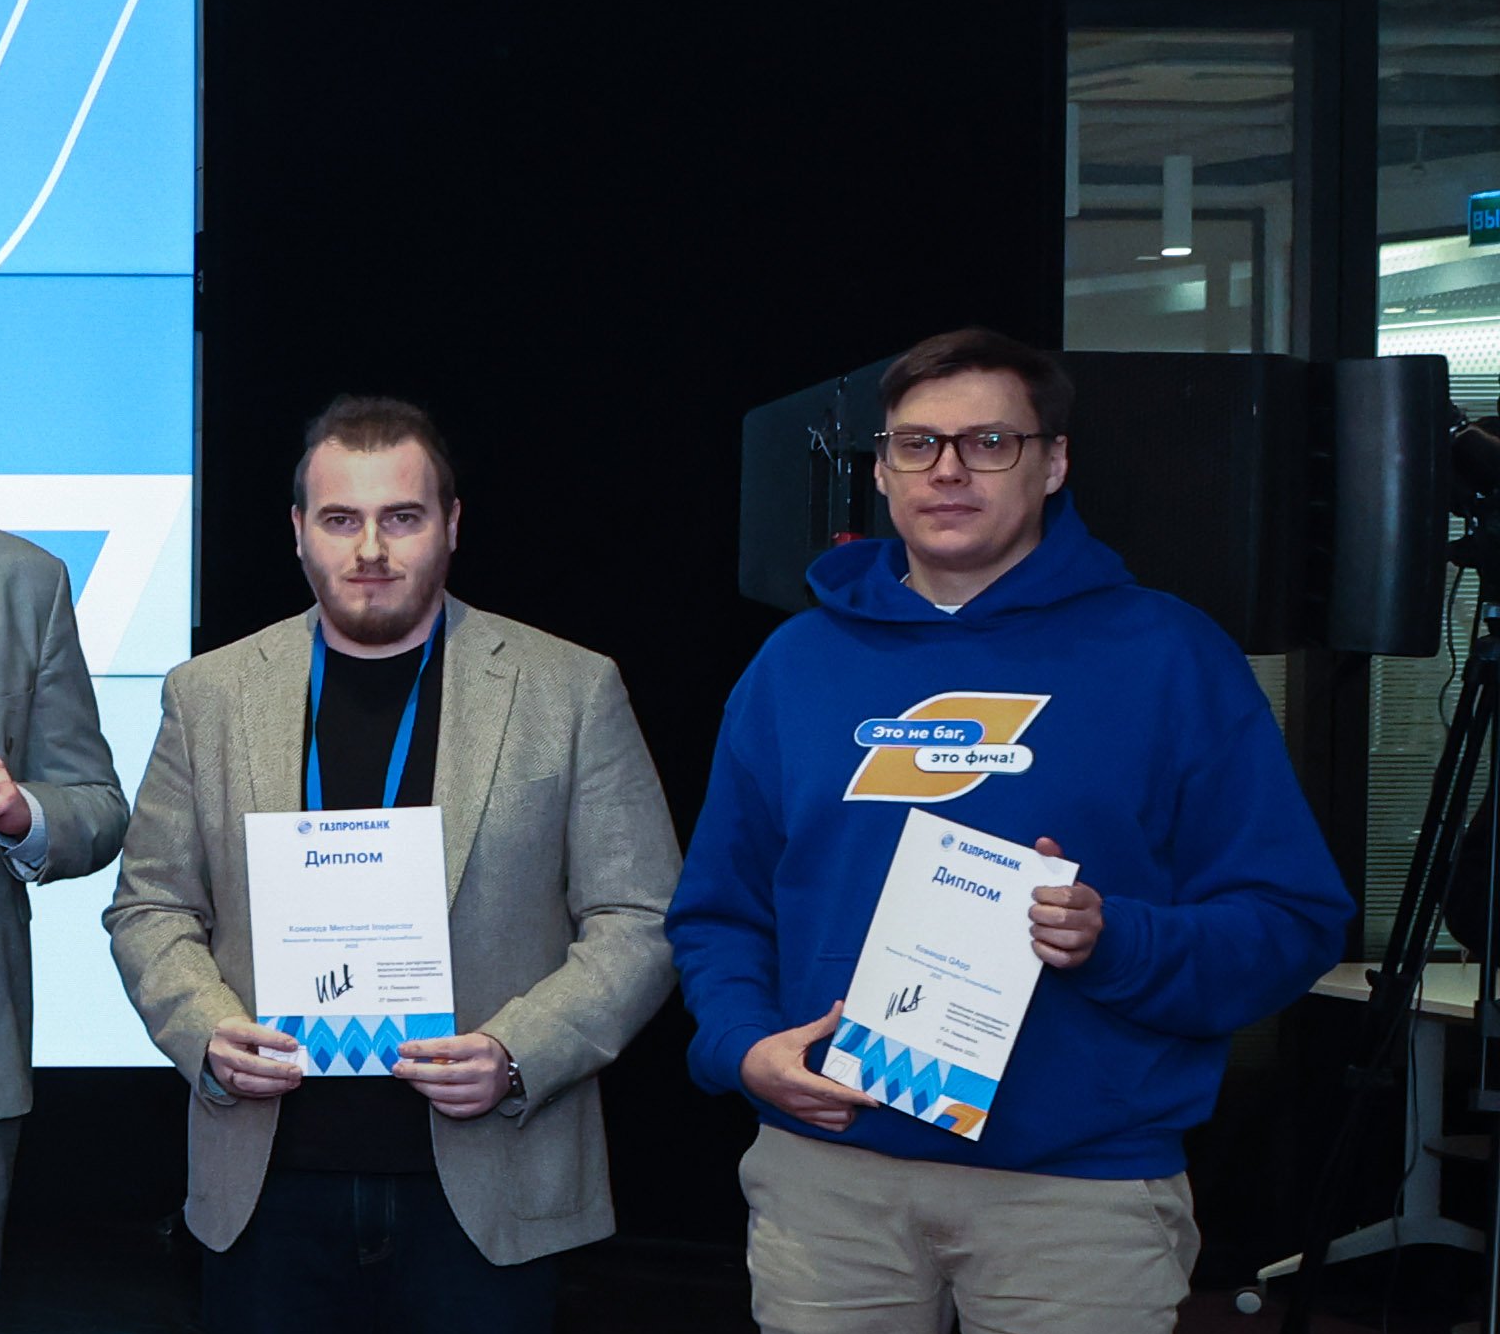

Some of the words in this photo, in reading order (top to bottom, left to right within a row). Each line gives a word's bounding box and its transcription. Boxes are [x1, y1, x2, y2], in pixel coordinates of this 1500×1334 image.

[872, 726, 904, 739] Это
[908, 728, 929, 739] не
[933, 725, 966, 742] баг,
[931, 752, 960, 764] это
[965, 750, 1016, 767] фича!
[319, 820, 391, 832] ГАЗПРОМБАНК
[304, 850, 383, 868] Диплом
[957, 840, 1022, 871] ГАЗПРОМБАНК
[931, 864, 1003, 903] Диплом
